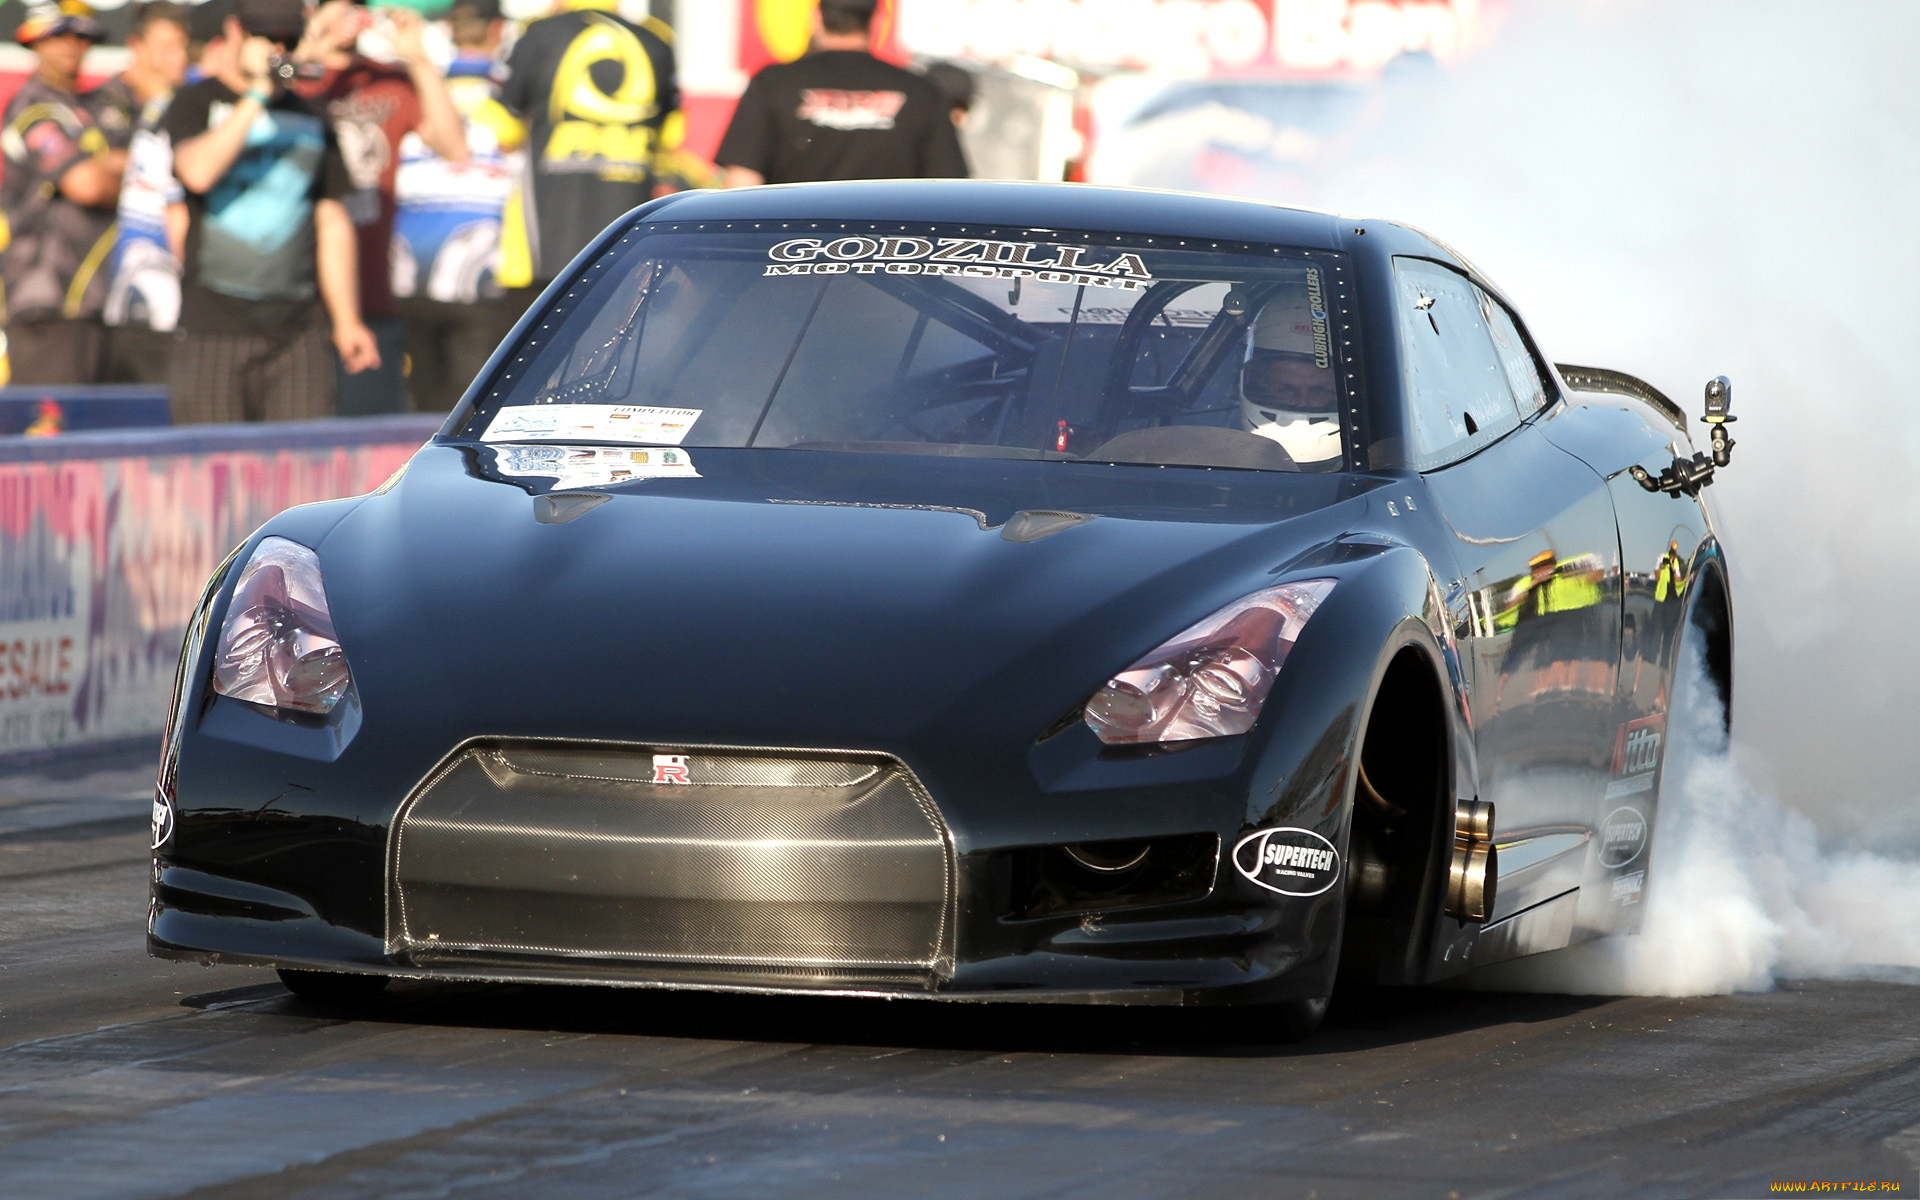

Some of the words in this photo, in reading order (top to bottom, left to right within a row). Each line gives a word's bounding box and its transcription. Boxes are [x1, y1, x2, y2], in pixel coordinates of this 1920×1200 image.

[768, 237, 1152, 278] GODZILLA
[762, 262, 1148, 292] MOTORSPORT
[1264, 843, 1334, 872] SUPERTECH
[1275, 868, 1297, 877] RACING
[1296, 870, 1315, 879] VALVES
